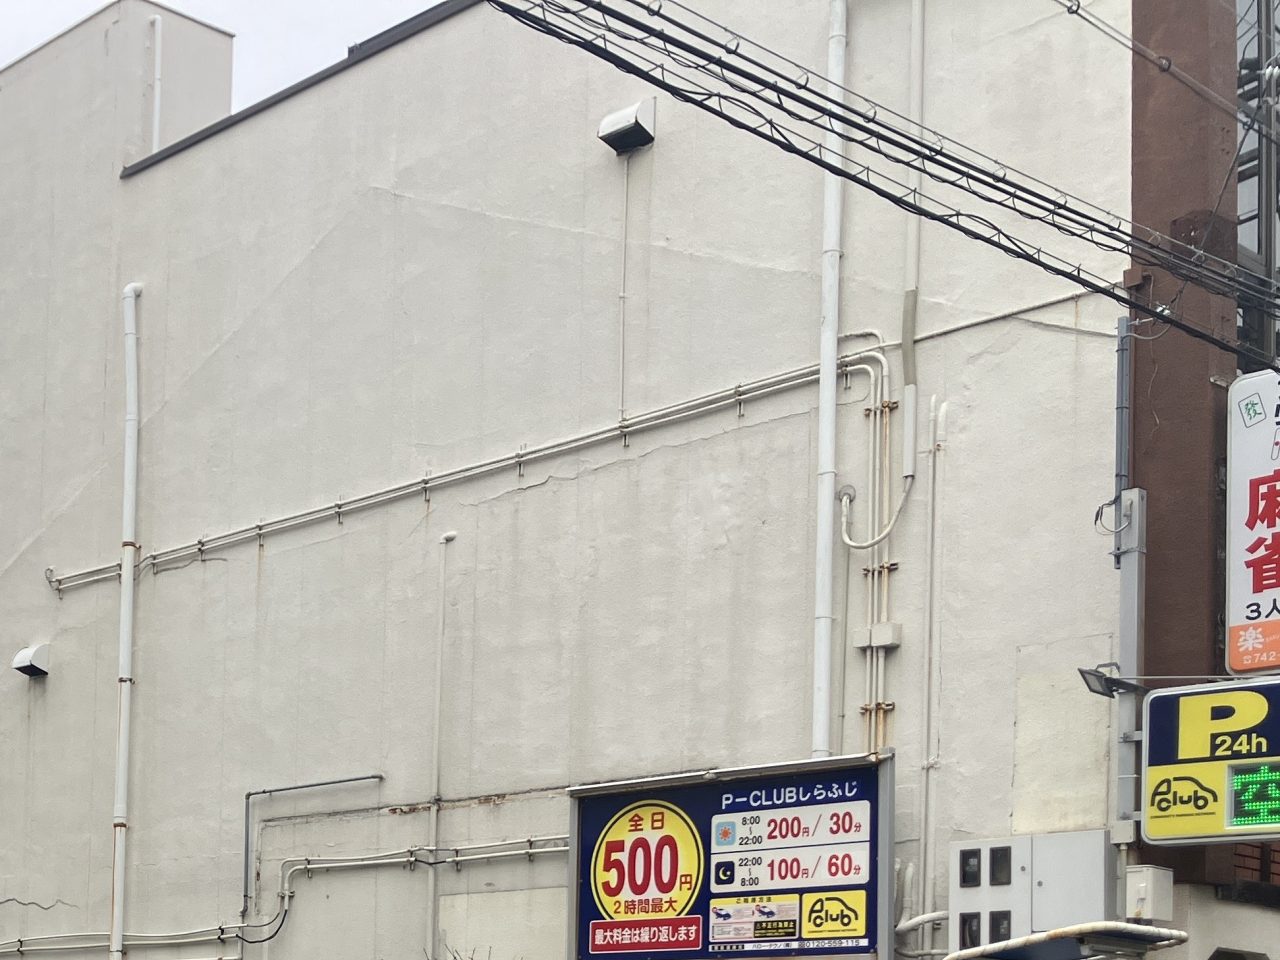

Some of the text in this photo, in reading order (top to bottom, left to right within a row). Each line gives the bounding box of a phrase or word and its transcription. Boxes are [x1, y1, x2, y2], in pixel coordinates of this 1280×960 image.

[1177, 690, 1269, 760] P
[1215, 732, 1268, 757] 24h
[628, 811, 665, 833] 全日
[741, 815, 761, 826] 8:00
[738, 835, 763, 846] 22:00
[738, 856, 763, 867] 22:00
[740, 877, 760, 887] 8:00
[613, 897, 677, 915] 2時間最大
[594, 924, 698, 945] 最大料金は繰り返します
